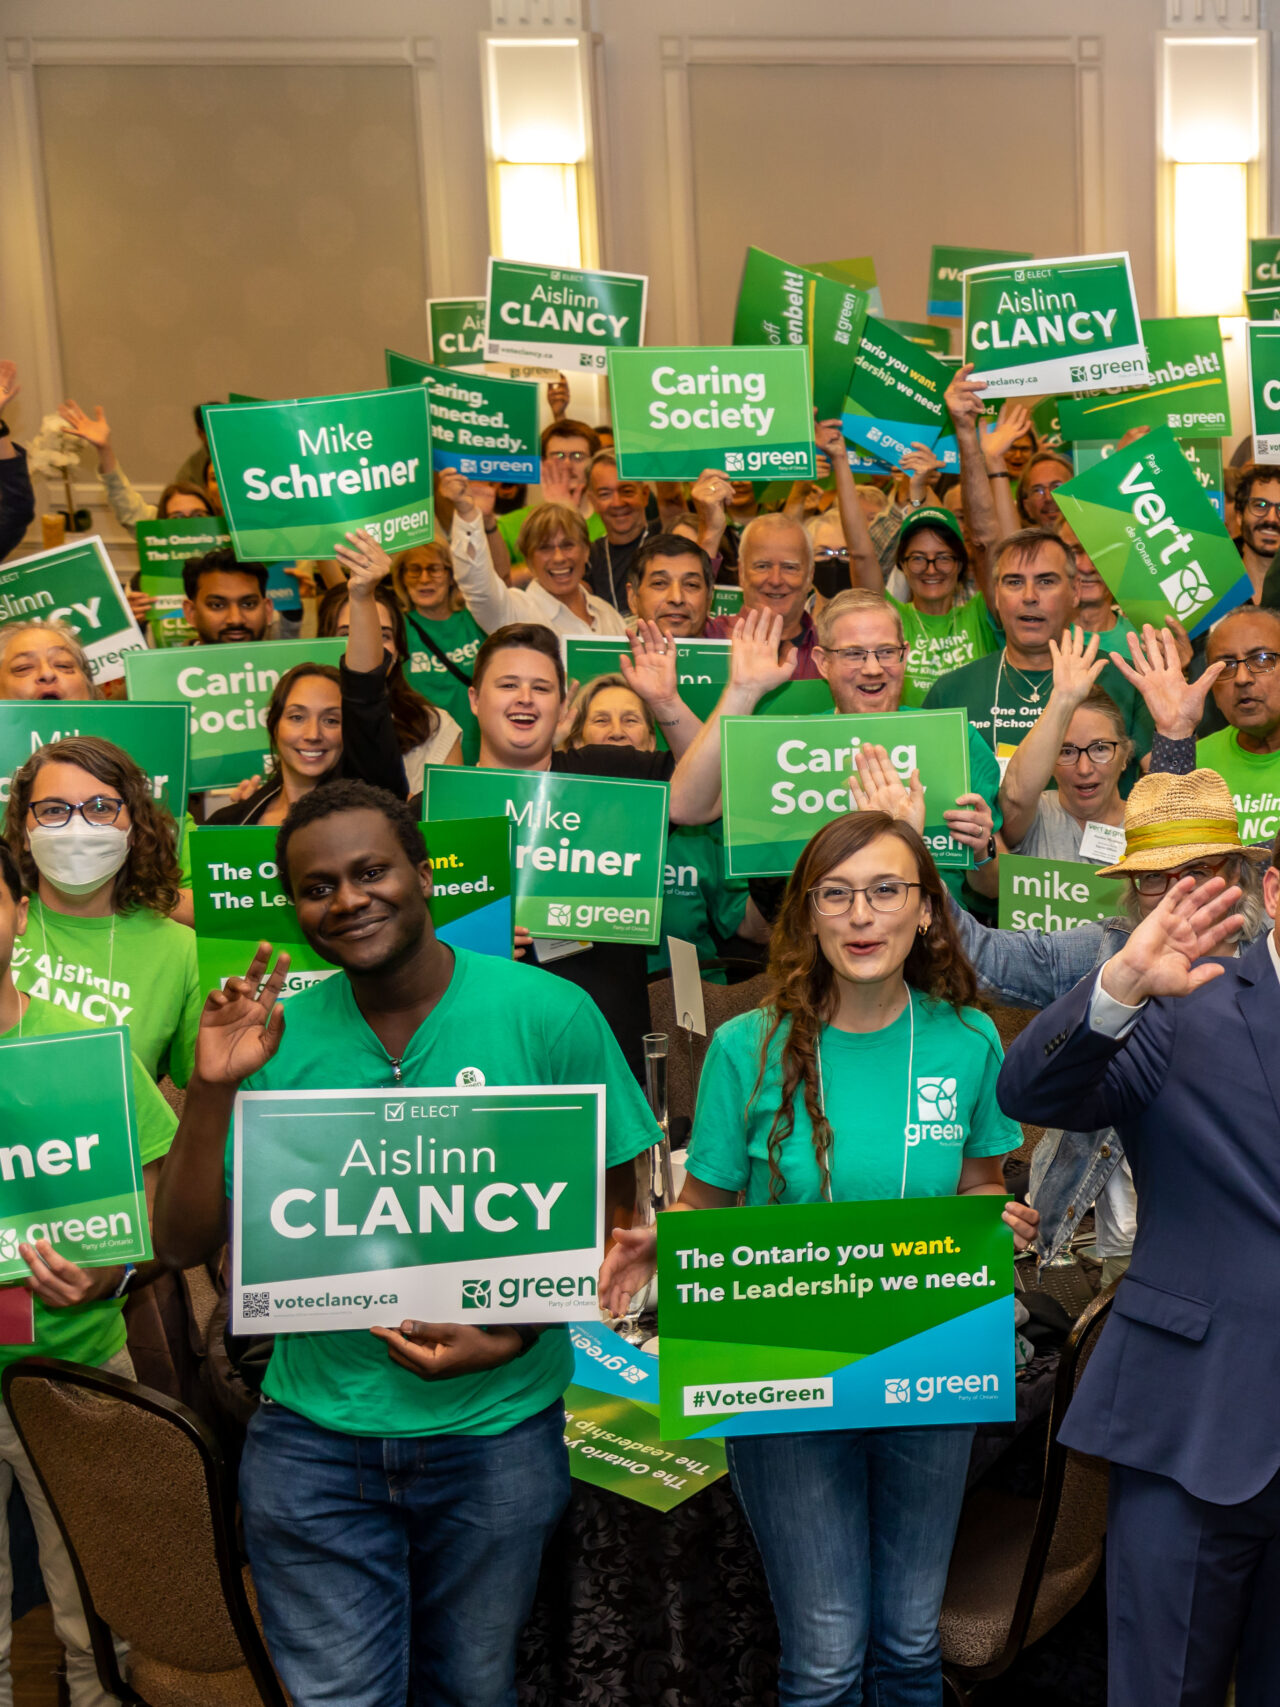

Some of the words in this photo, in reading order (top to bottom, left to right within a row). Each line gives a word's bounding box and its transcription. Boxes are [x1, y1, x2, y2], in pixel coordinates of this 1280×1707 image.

[562, 272, 584, 282] ELECT
[1027, 269, 1051, 280] ELECT
[530, 284, 599, 309] Aislinn
[997, 288, 1077, 314] Aislinn
[500, 301, 630, 338] CLANCY
[837, 292, 856, 331] green
[761, 320, 781, 345] off
[971, 308, 1118, 350] CLANCY
[651, 365, 767, 401] Caring
[888, 355, 909, 374] you
[909, 366, 937, 393] want.
[986, 375, 1038, 388] teclancy.ca
[1090, 358, 1144, 381] green
[421, 376, 489, 408] Caring.
[896, 381, 914, 398] we
[914, 393, 942, 416] need.
[430, 403, 509, 429] nnected.
[649, 400, 776, 437] Society
[1182, 411, 1226, 429] green
[298, 423, 373, 456] Mike
[457, 428, 527, 454] Ready.
[480, 459, 533, 474] green
[747, 448, 808, 471] green
[1145, 452, 1164, 475] Parti
[243, 457, 419, 501] Schreiner
[383, 510, 429, 542] green
[1117, 461, 1195, 566] vert
[145, 536, 167, 547] The
[1125, 526, 1137, 539] de
[1133, 537, 1158, 576] l'Ontario
[146, 551, 169, 561] The
[177, 661, 290, 699] Carin
[990, 706, 1016, 716] One
[776, 736, 917, 779] Carig
[505, 798, 581, 831] Mike
[516, 837, 641, 877] reiner
[208, 863, 253, 881] The
[433, 876, 496, 897] need.
[1013, 870, 1090, 904] mike
[210, 892, 254, 910] The
[576, 903, 650, 928] green
[34, 954, 131, 1000] Aislinn
[411, 1105, 460, 1118] ELECT
[904, 1123, 964, 1146] green
[340, 1135, 496, 1176] Aislinn
[270, 1181, 568, 1239] CLANCY
[26, 1211, 132, 1246] green
[81, 1241, 98, 1251] Party
[107, 1237, 134, 1248] Ontario
[677, 1249, 725, 1270] The
[732, 1241, 830, 1266] Ontario
[837, 1239, 885, 1264] you
[891, 1235, 962, 1258] want.
[273, 1292, 399, 1310] voteclancy.ca
[499, 1274, 596, 1308] green
[677, 1282, 726, 1304] The
[732, 1273, 874, 1301] Leadership
[881, 1271, 919, 1291] we
[925, 1265, 997, 1289] need.
[548, 1300, 563, 1309] Party
[565, 1299, 571, 1307] of
[573, 1299, 597, 1308] Ontario
[692, 1384, 826, 1409] #VoteGreen
[915, 1373, 999, 1403] green
[958, 1395, 972, 1403] Party
[980, 1393, 999, 1401] Ontario
[575, 1420, 675, 1462] Leadership
[581, 1445, 650, 1475] Ontario
[674, 1456, 711, 1476] The
[652, 1469, 688, 1491] The
